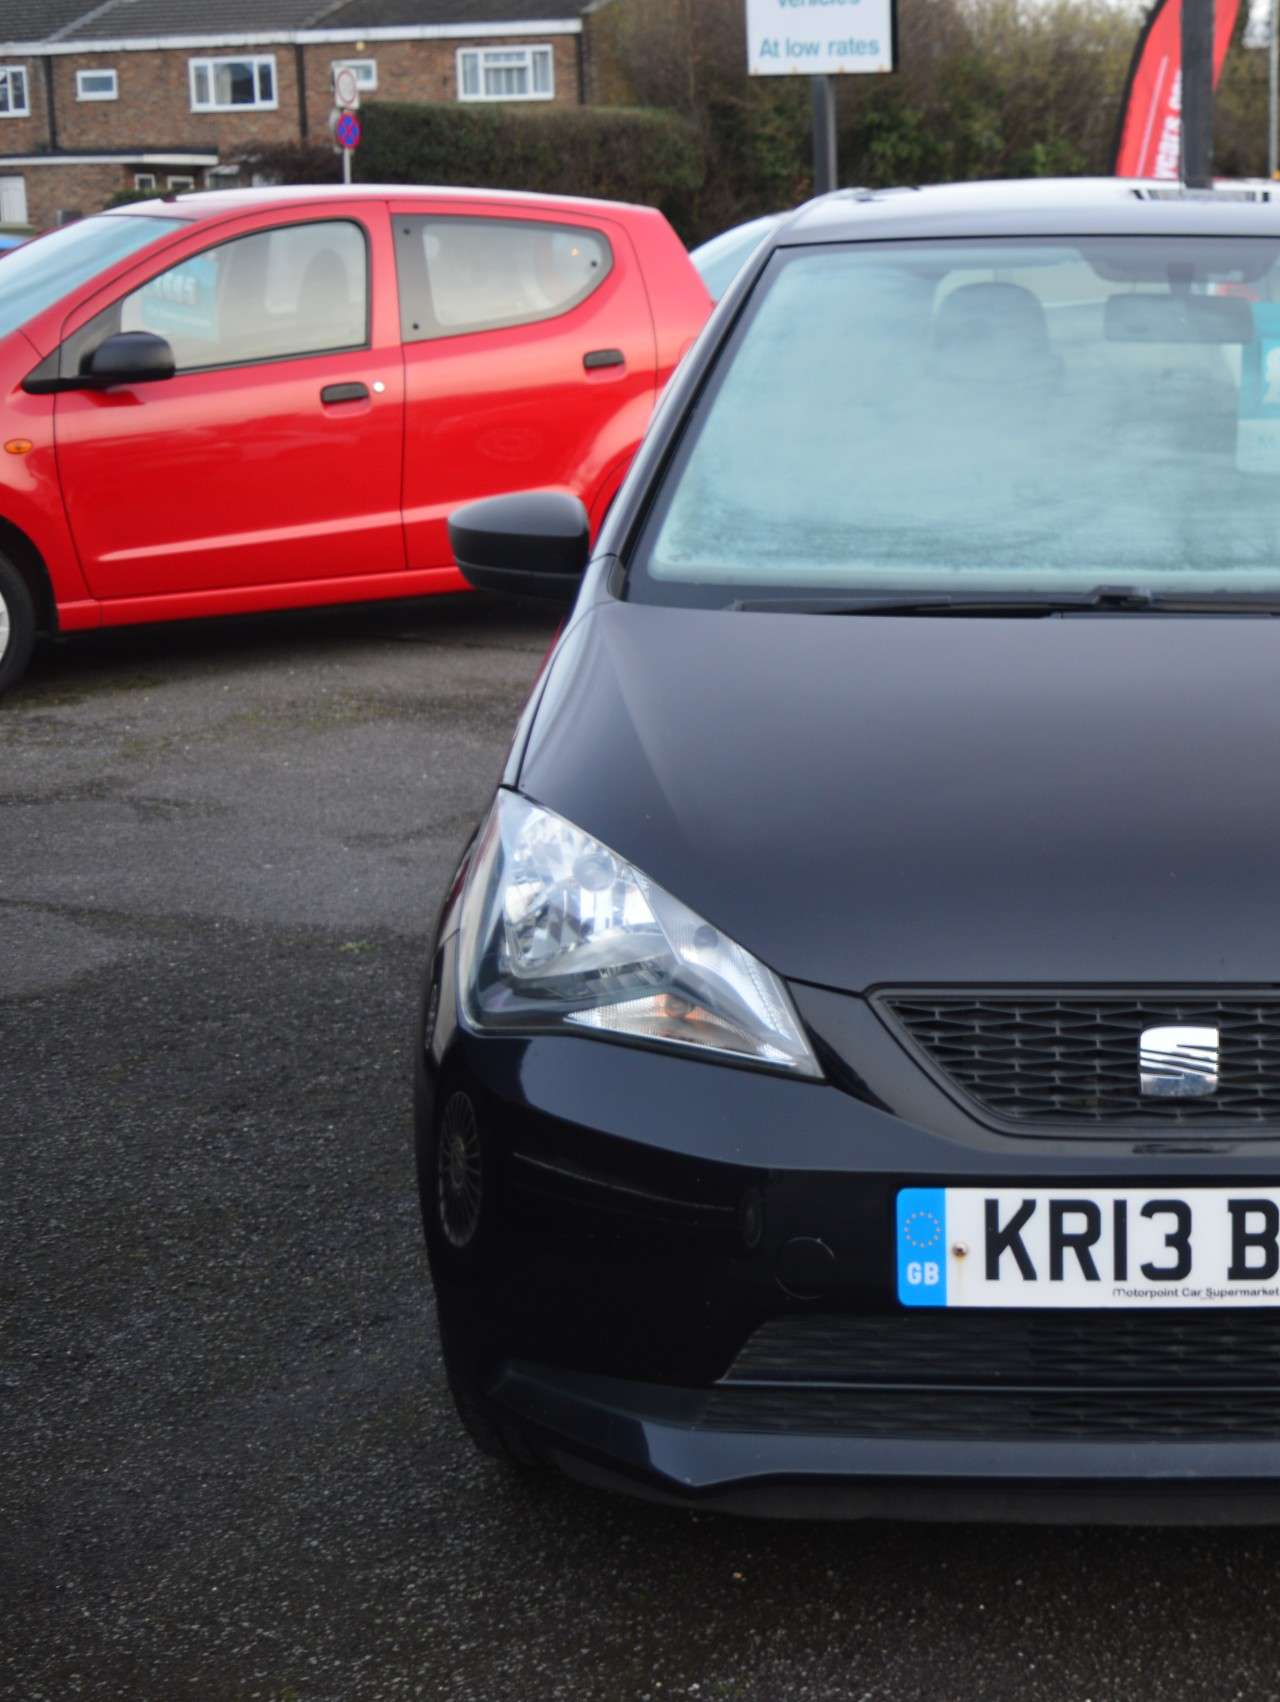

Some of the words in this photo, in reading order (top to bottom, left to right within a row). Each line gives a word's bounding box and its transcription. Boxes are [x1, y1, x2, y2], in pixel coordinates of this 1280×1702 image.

[759, 38, 780, 58] At
[785, 38, 820, 58] low
[827, 37, 881, 57] rates
[984, 1198, 1193, 1281] KR13
[907, 1261, 939, 1286] GB
[1112, 1286, 1179, 1298] Motorpoint
[1181, 1286, 1202, 1298] Car
[1205, 1286, 1280, 1299] Supermarket
